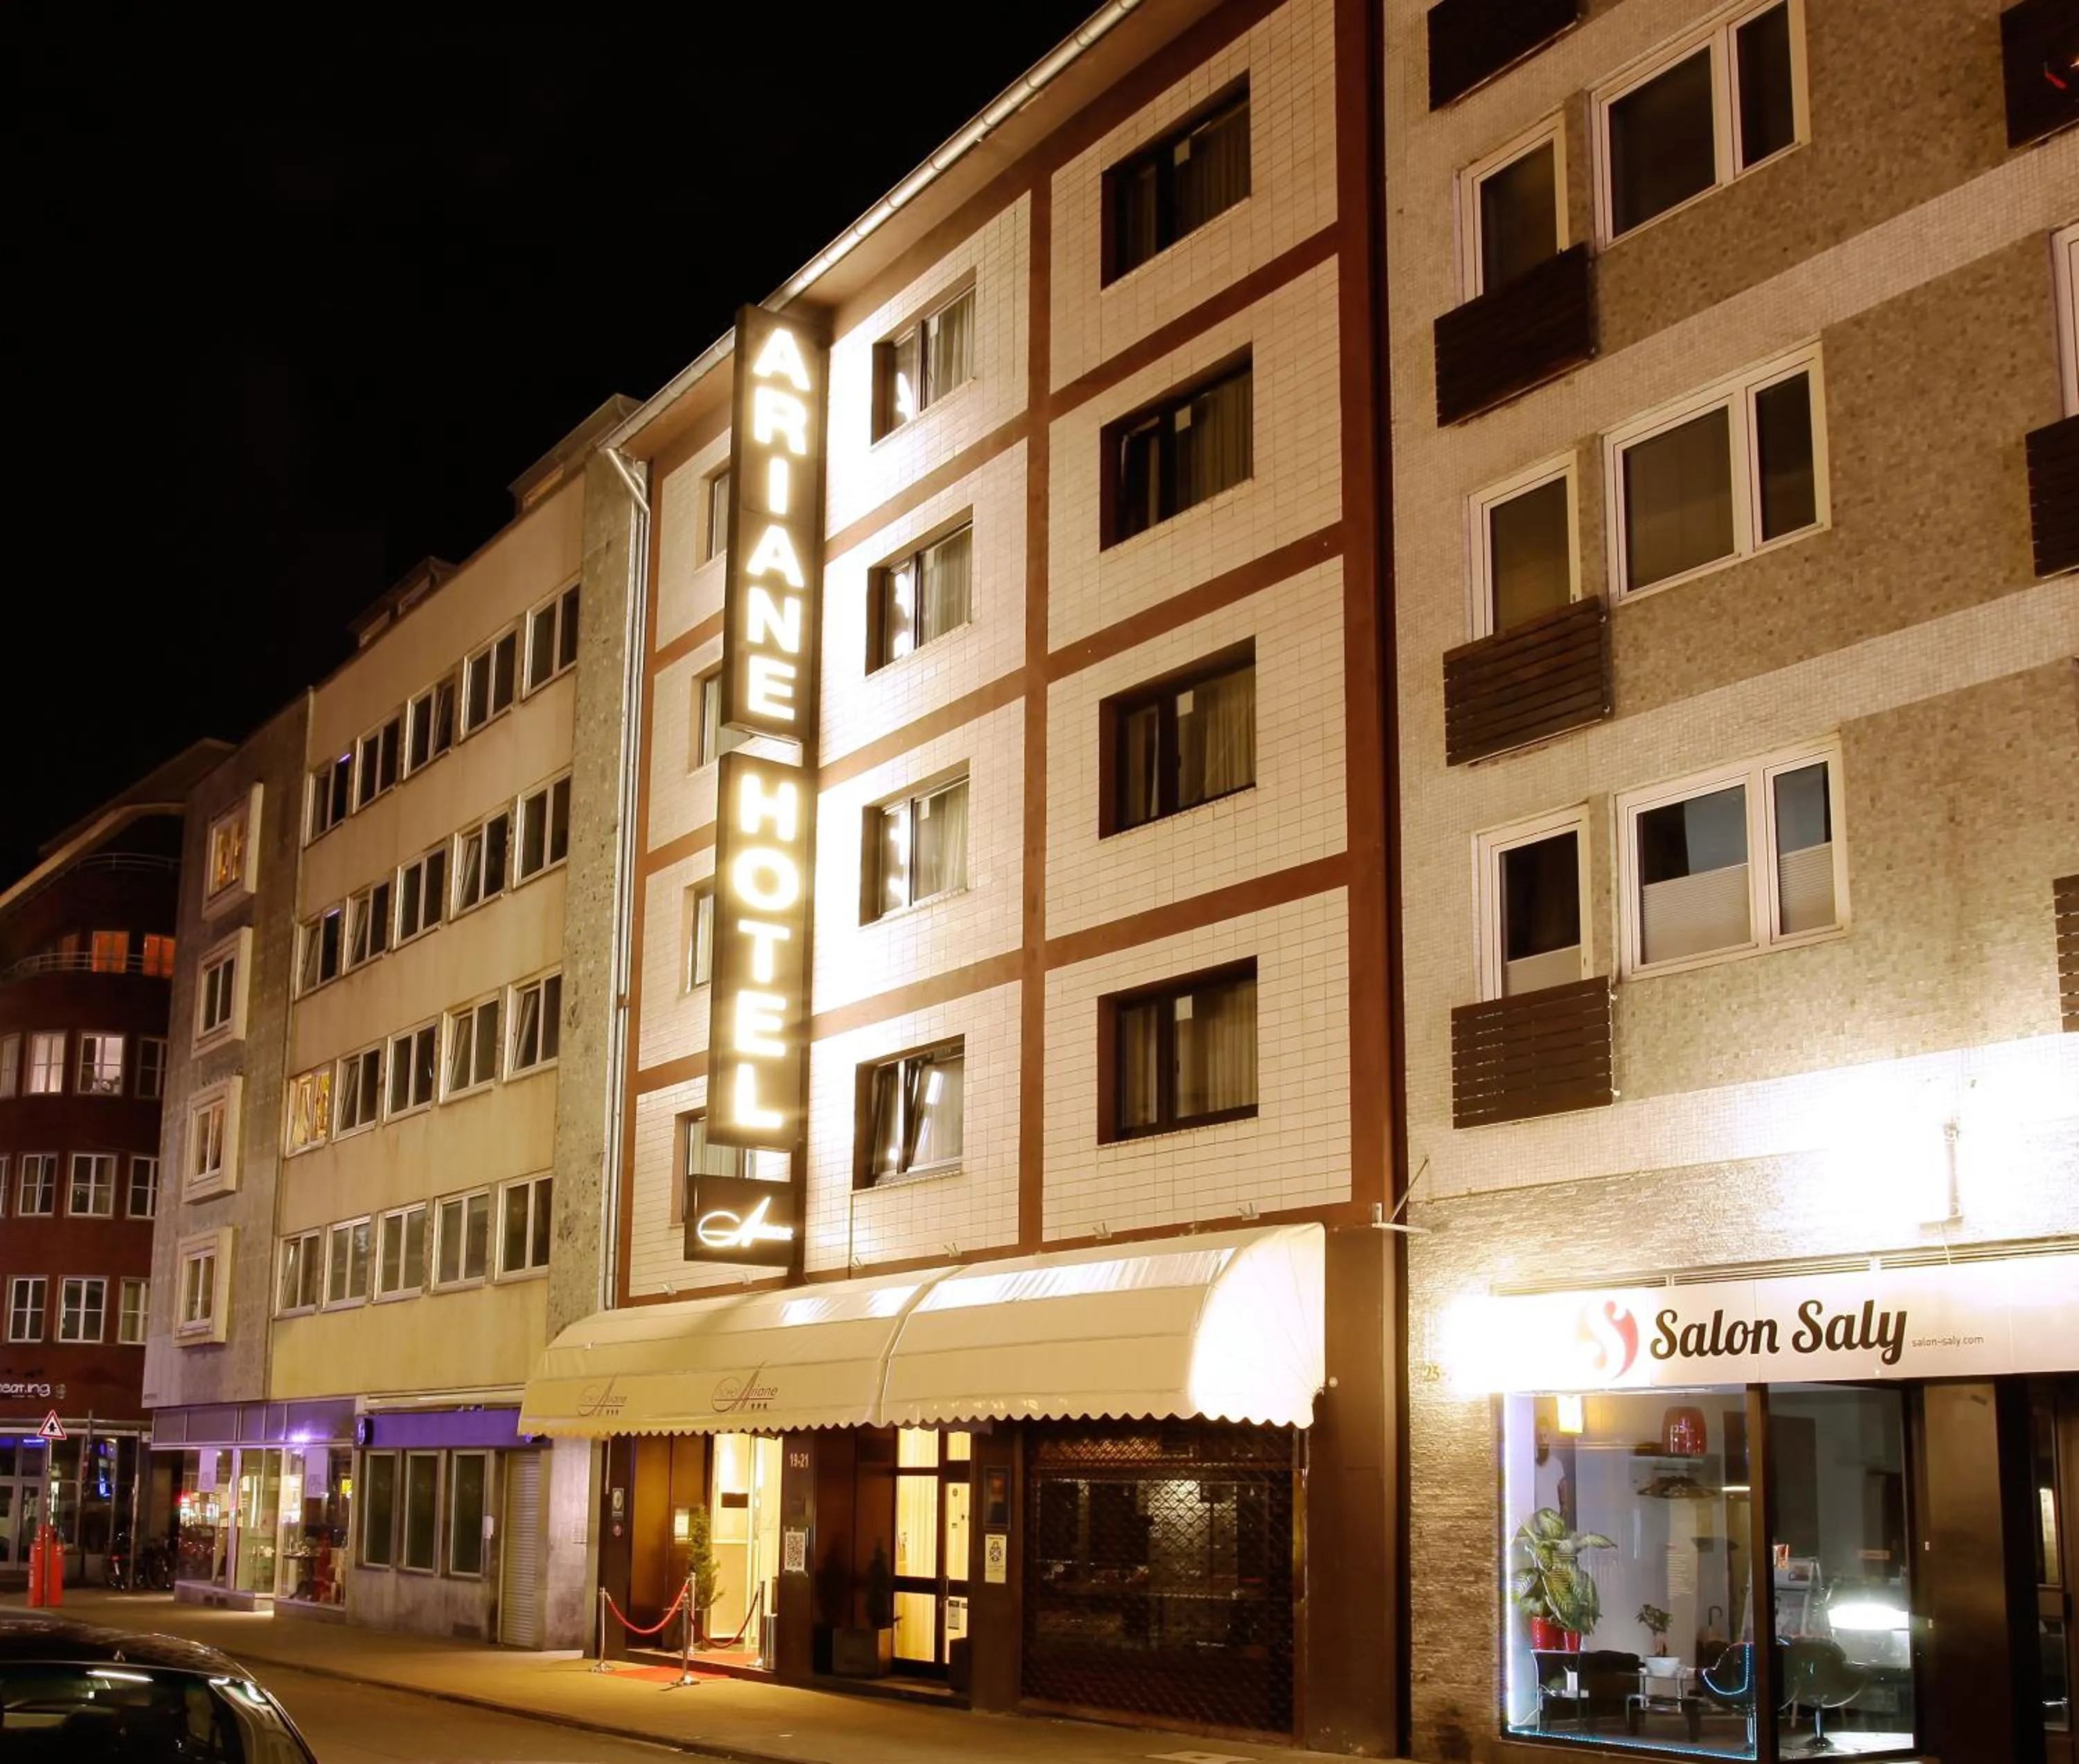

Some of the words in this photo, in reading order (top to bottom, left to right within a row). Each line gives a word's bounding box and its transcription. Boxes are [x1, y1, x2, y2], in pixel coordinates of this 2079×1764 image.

[746, 328, 810, 721] ARIANE
[732, 773, 800, 1129] HOTEL
[1651, 1309, 1780, 1359] Salon
[1791, 1299, 1907, 1365] Saly
[1911, 1335, 1984, 1347] salon-saly.com
